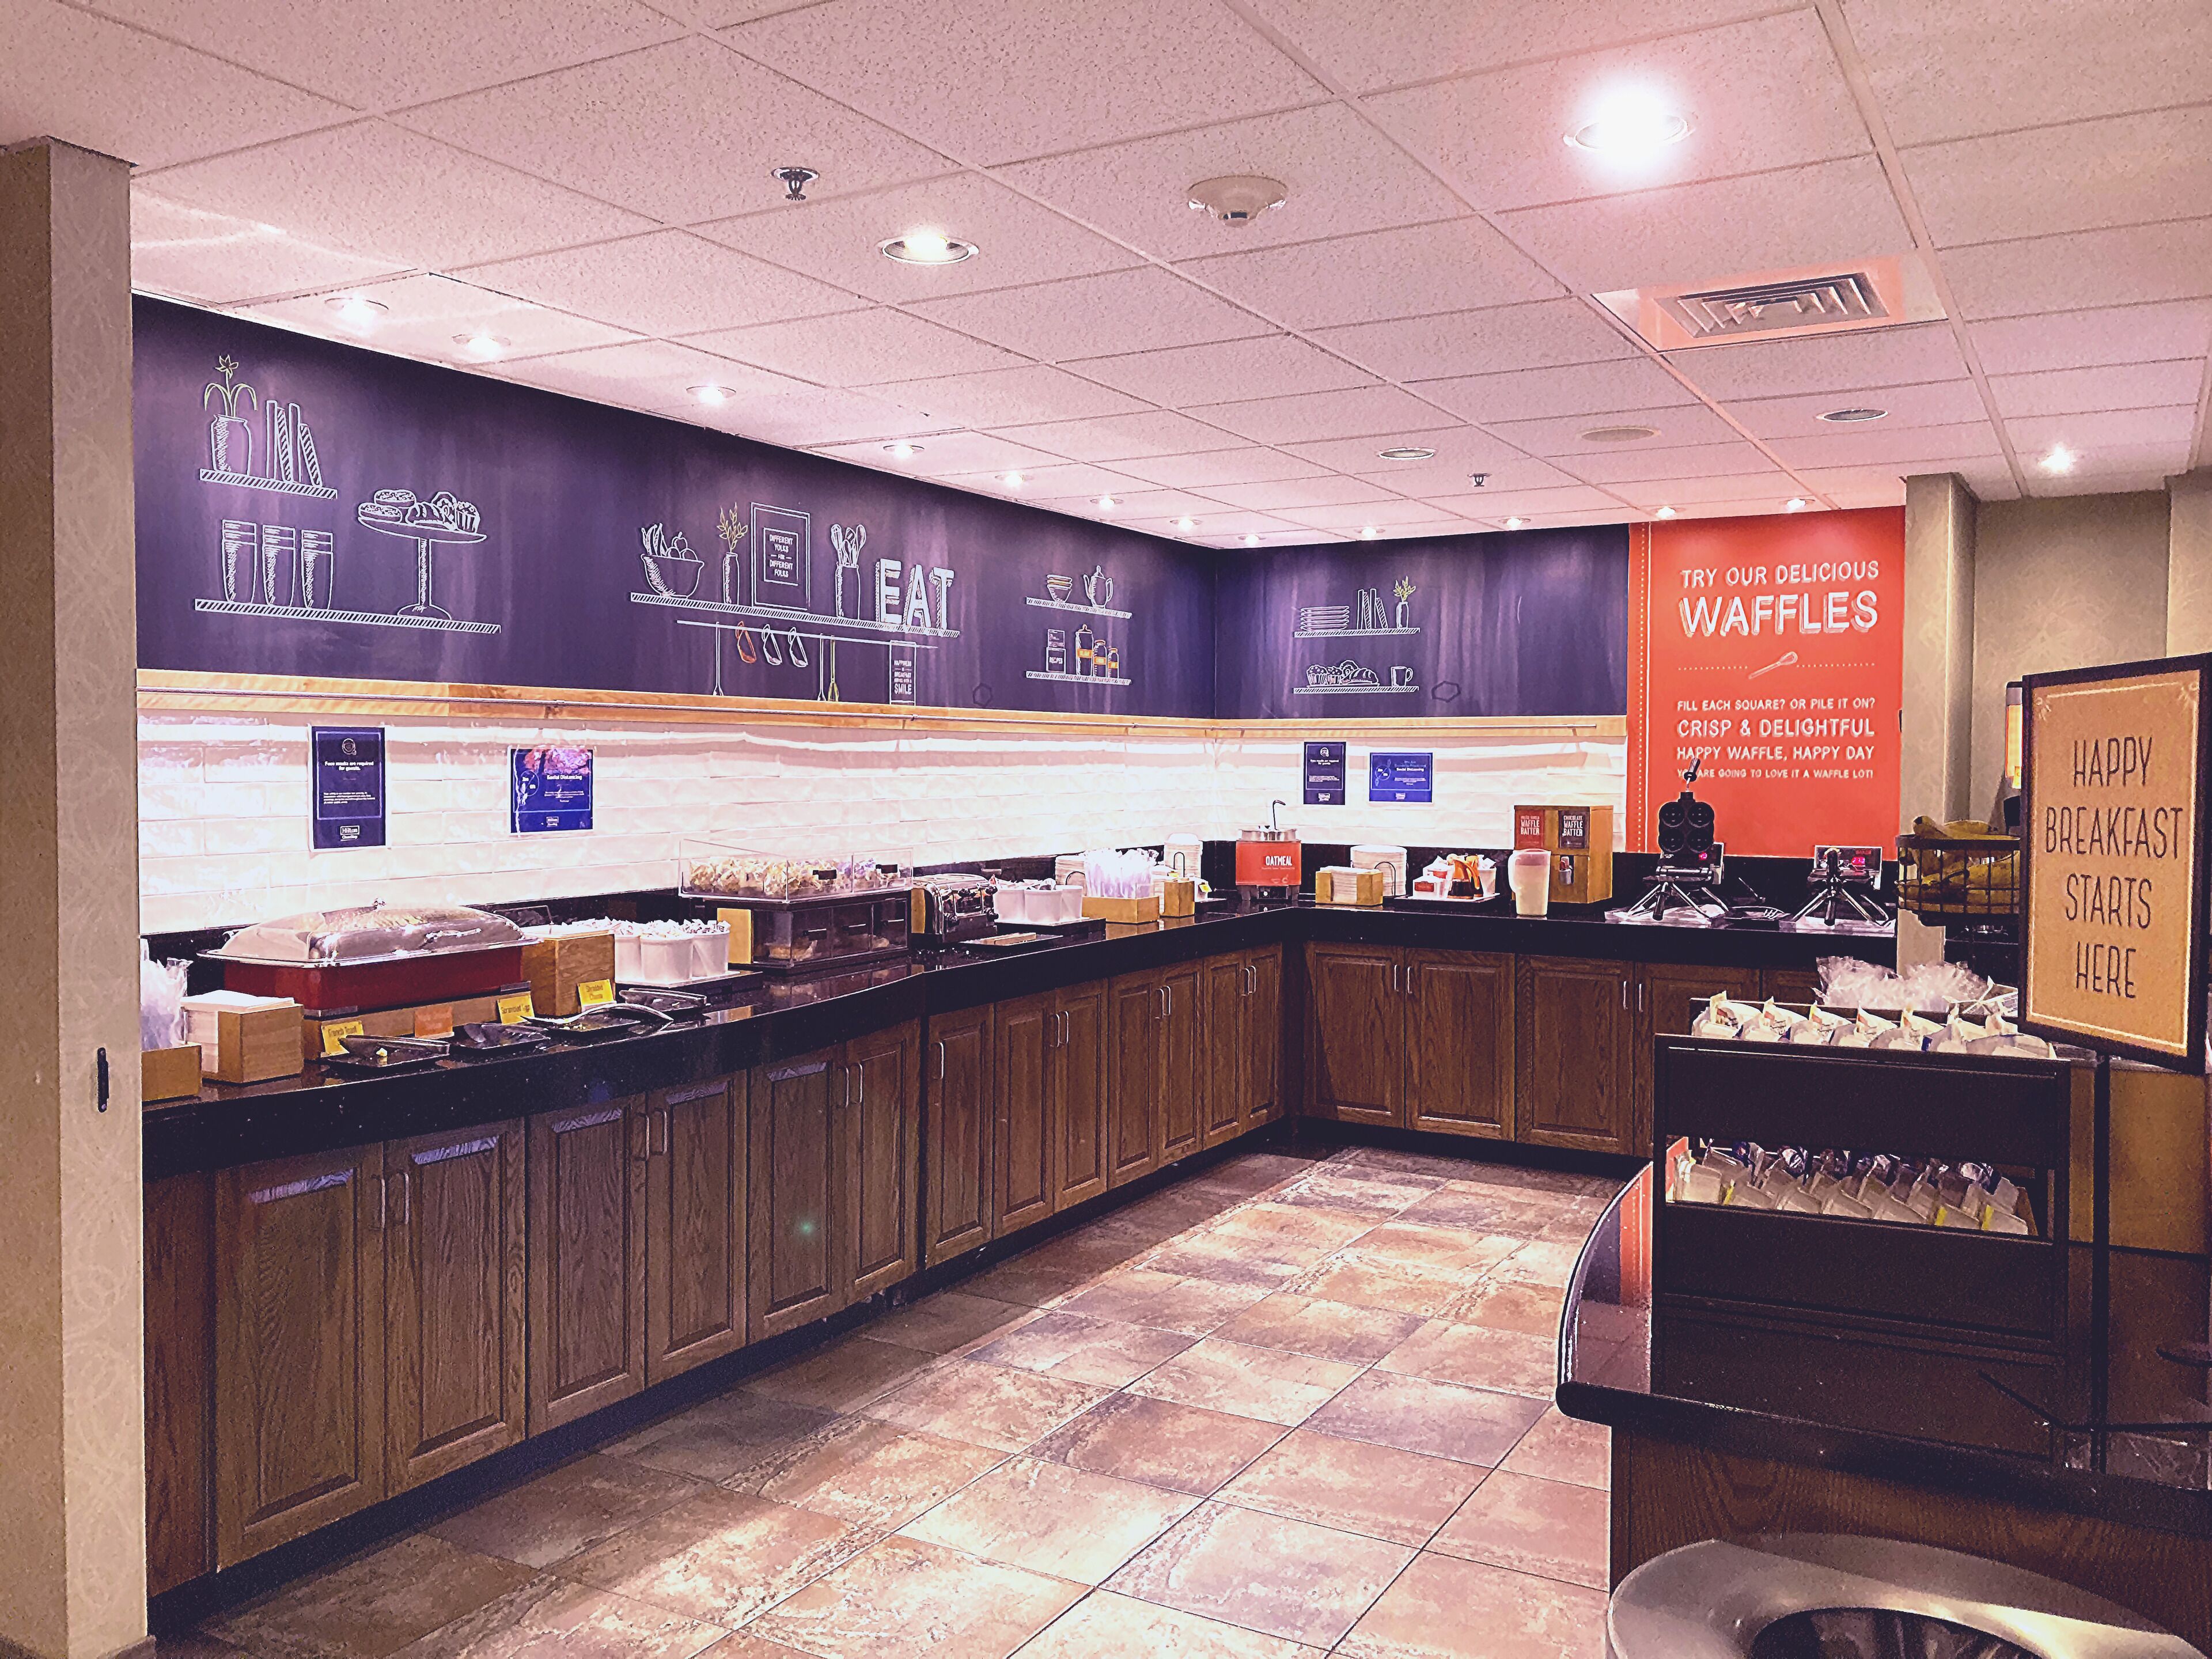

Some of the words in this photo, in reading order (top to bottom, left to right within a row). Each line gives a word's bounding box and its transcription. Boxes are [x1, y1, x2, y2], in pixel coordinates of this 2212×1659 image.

[769, 534, 793, 545] DIFFERENT
[774, 543, 789, 553] YOLKS
[769, 559, 793, 570] DIFFERENT
[774, 569, 789, 578] FOLKS
[1680, 568, 1717, 588] TRY
[1726, 566, 1767, 586] OUR
[1775, 560, 1879, 584] DELICIOUS
[876, 558, 955, 630] EAT
[1679, 590, 1878, 638] WAFFLES
[894, 683, 912, 695] SMILE
[1677, 700, 1698, 711] FILL
[1702, 700, 1730, 711] EACH
[1734, 699, 1785, 711] SQUARE?
[1790, 698, 1806, 710] OR
[1810, 698, 1834, 710] PILE
[1838, 698, 1848, 709] IT
[1853, 697, 1875, 709] ON?
[1677, 719, 1732, 737] CRISP
[1740, 719, 1751, 737] &
[1759, 718, 1874, 737] DELIGHTFUL
[1677, 747, 1721, 760] HAPPY
[1727, 746, 1787, 761] WAFFLE,
[1793, 746, 1840, 760] HAPPY
[1846, 745, 1874, 760] DAY
[2073, 736, 2153, 787] HAPPY
[1698, 769, 1715, 777] ARE
[1718, 769, 1747, 778] GOING
[1751, 769, 1762, 778] TO
[1766, 769, 1788, 778] LOVE
[1791, 769, 1800, 778] IT
[1803, 769, 1809, 778] A
[1813, 769, 1849, 778] WAFFLE
[1521, 819, 1540, 828] WAFFLE
[1563, 820, 1583, 828] WAFFLE
[1521, 827, 1540, 835] BATTER
[1563, 828, 1583, 836] BATTER
[2046, 806, 2183, 859] BREAKFAST
[1266, 855, 1292, 866] OATMEAL
[2066, 873, 2152, 929] STARTS
[2075, 941, 2137, 999] HERE
